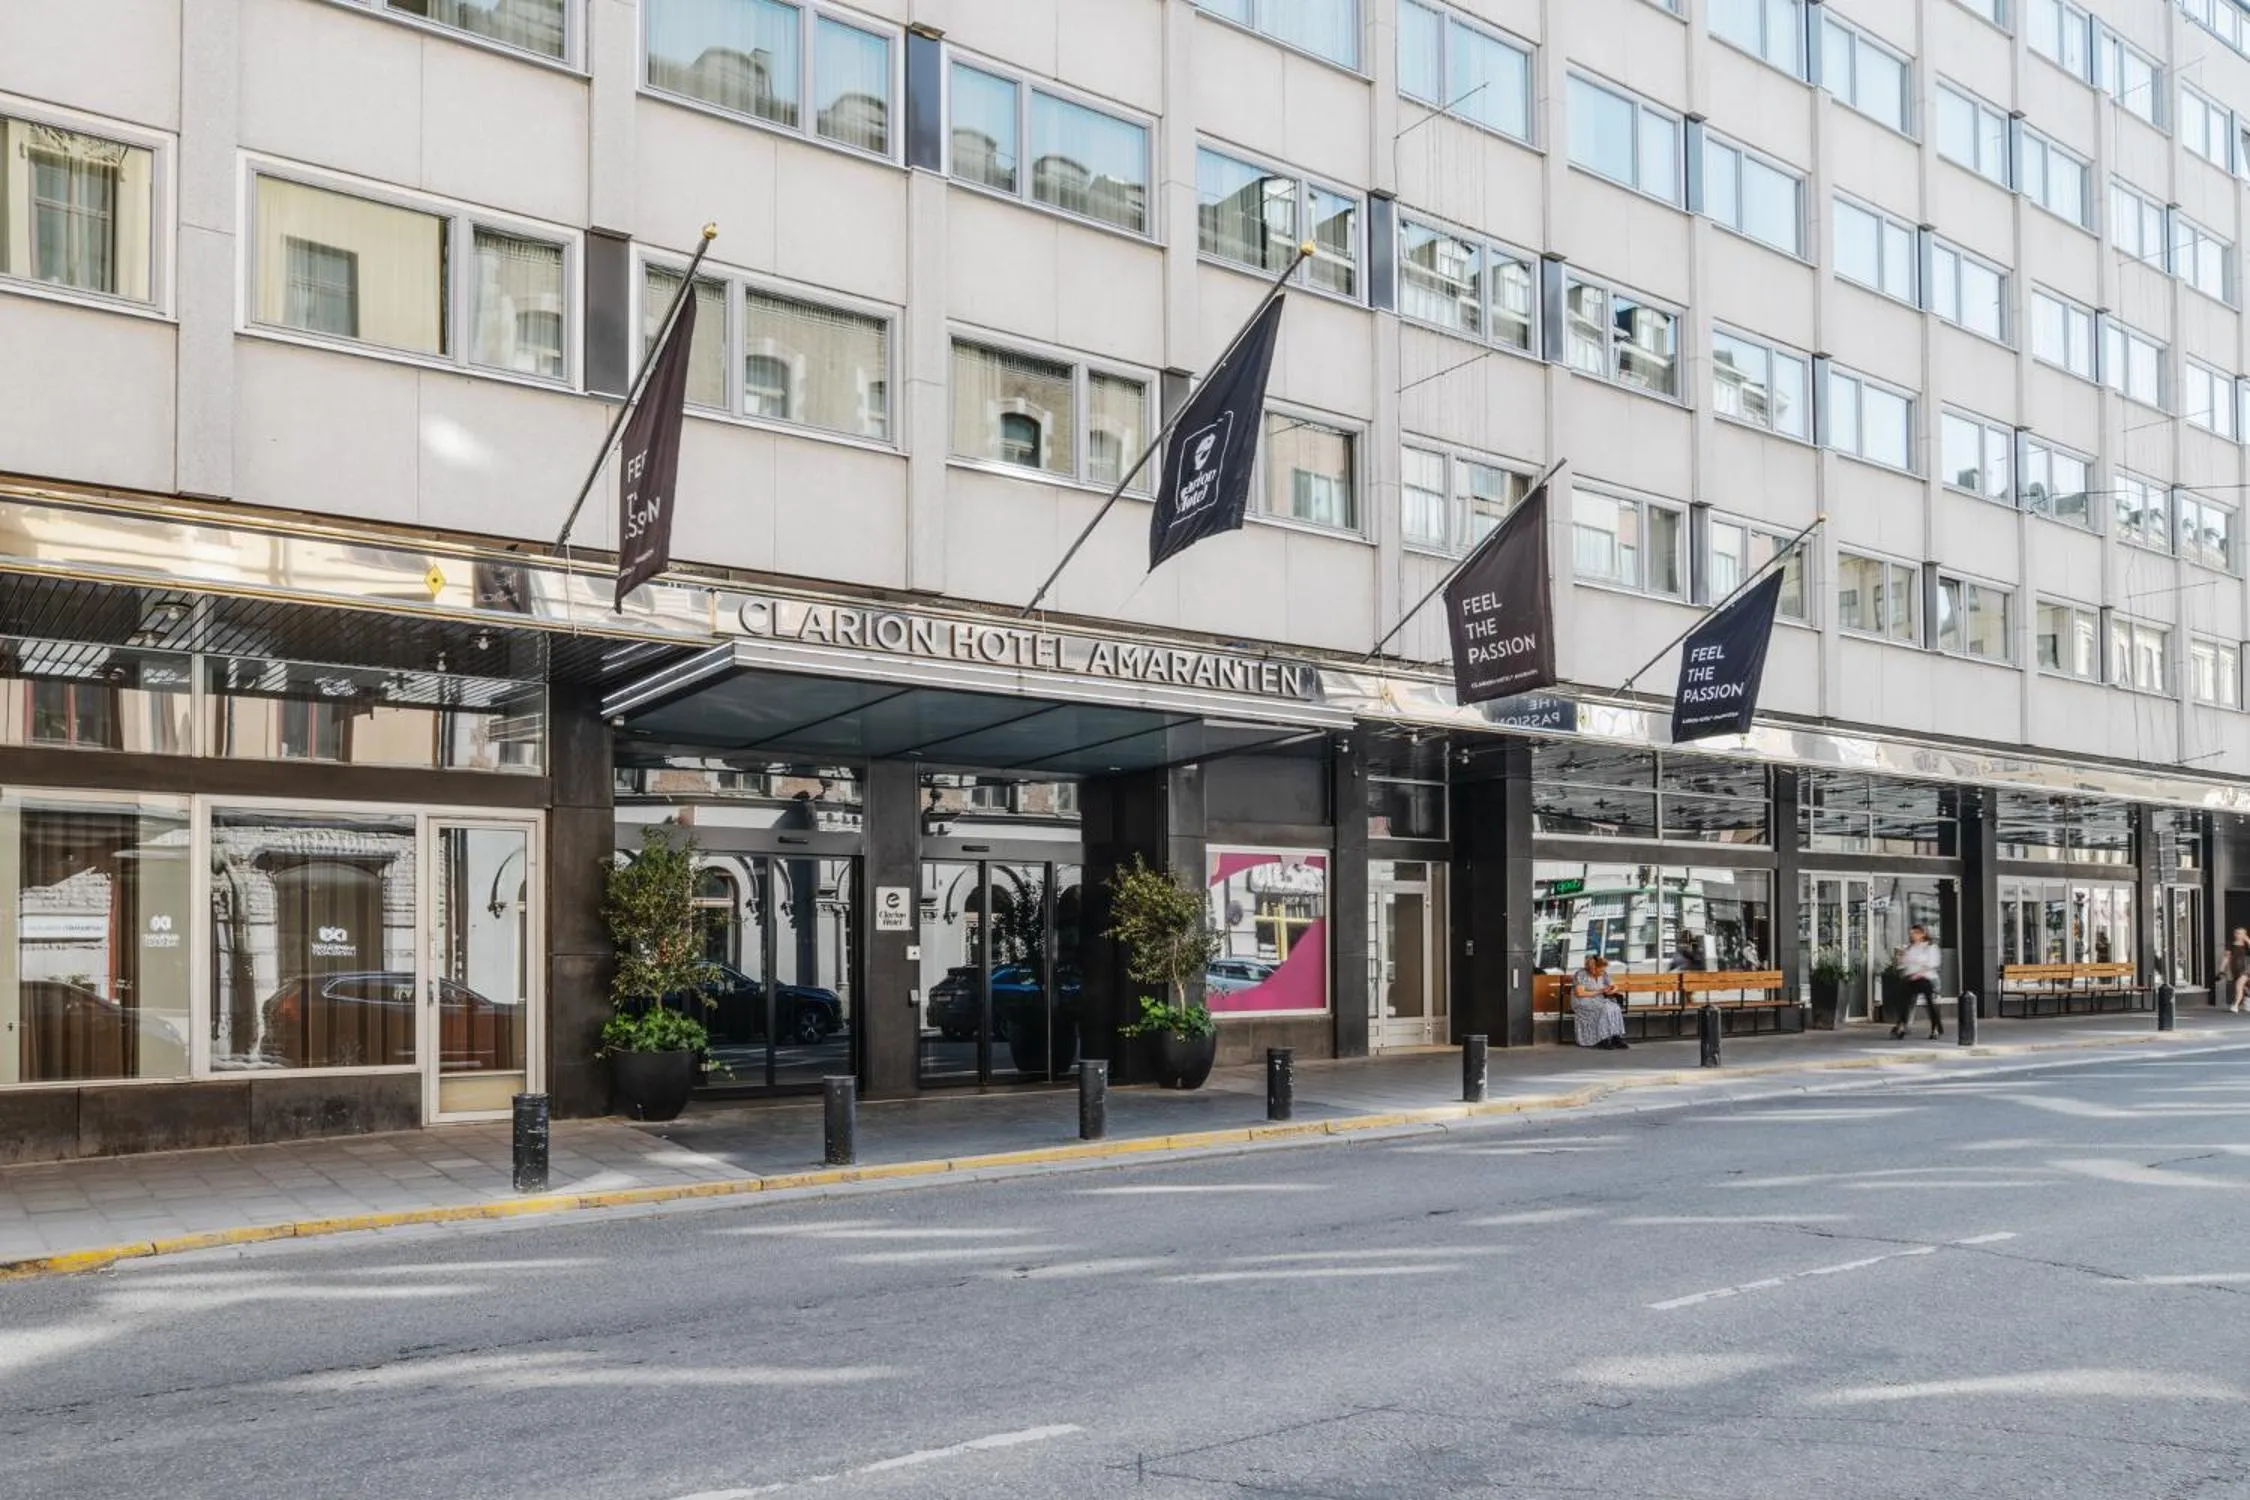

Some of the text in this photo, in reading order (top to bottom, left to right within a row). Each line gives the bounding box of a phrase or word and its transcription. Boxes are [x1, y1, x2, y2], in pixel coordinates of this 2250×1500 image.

[1462, 592, 1503, 616] FEEL
[1465, 618, 1498, 640] THE
[738, 597, 1301, 696] CLARION HOTEL AMARANTEN
[1468, 633, 1536, 665] PASSION
[1691, 644, 1725, 663] FEEL
[1687, 666, 1715, 682] THE
[1683, 682, 1744, 703] PASSION
